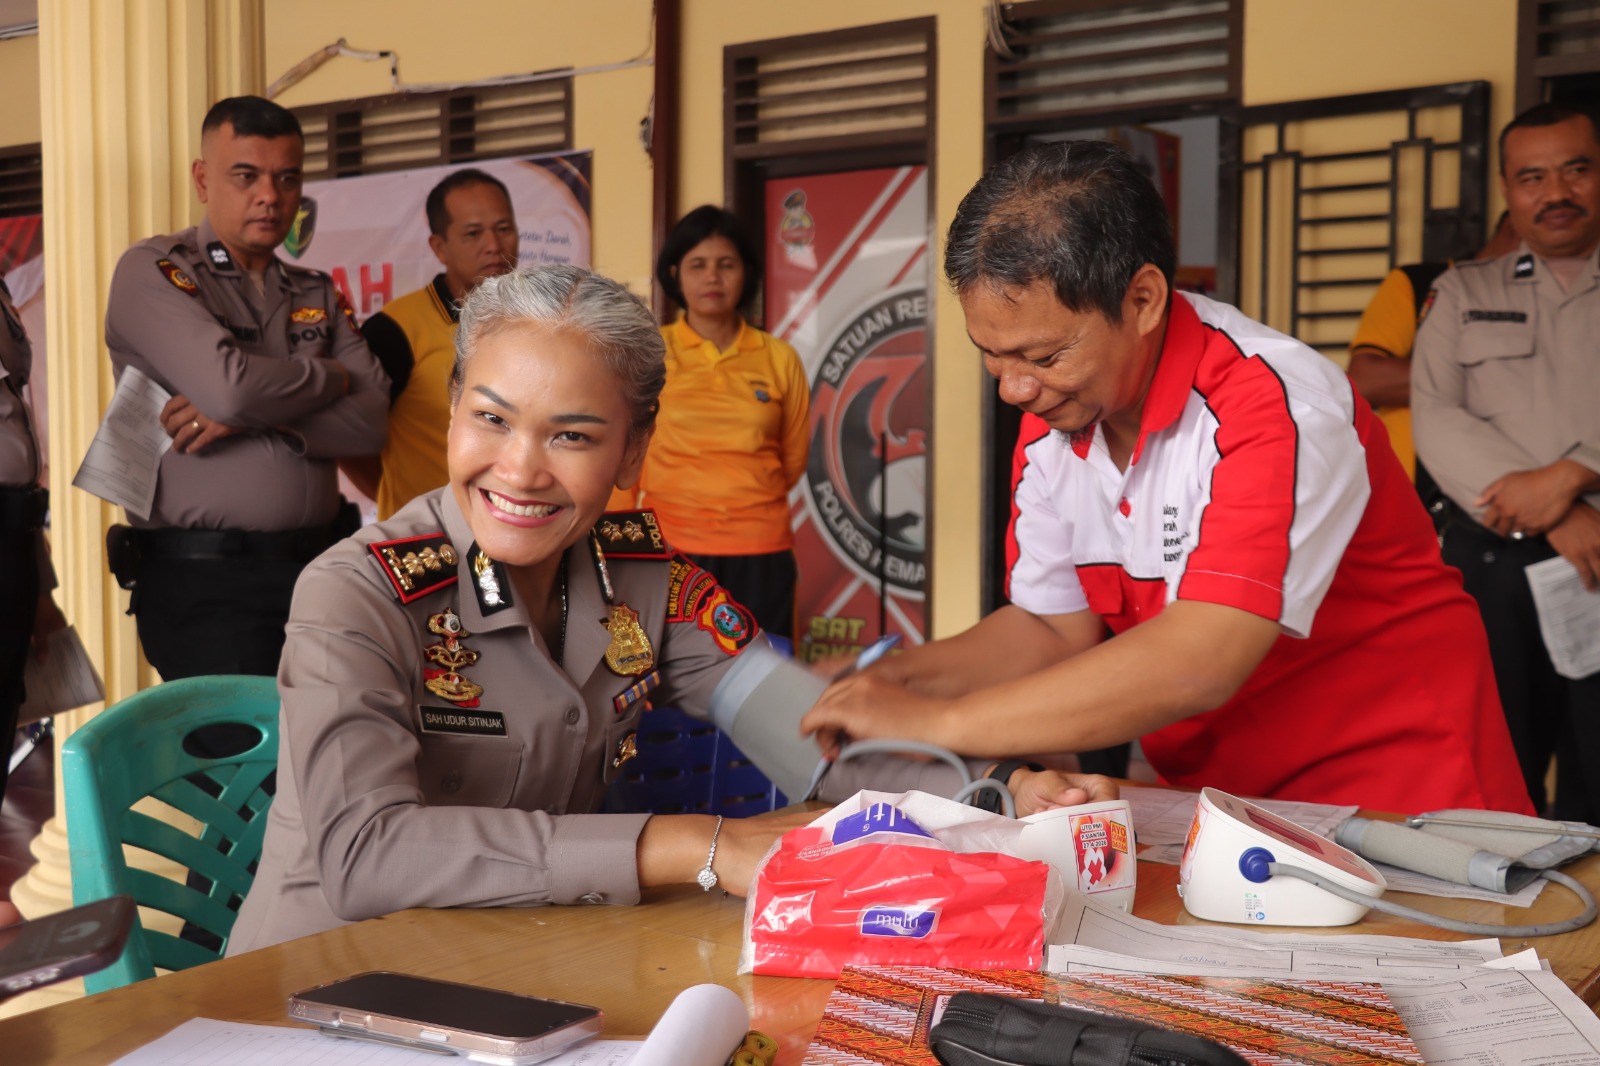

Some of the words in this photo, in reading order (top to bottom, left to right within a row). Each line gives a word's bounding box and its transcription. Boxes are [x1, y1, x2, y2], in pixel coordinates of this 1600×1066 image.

[822, 306, 893, 383] SATUAN
[644, 512, 664, 549] POLISI
[815, 481, 873, 561] POLRES
[811, 616, 866, 641] SAT
[425, 713, 443, 724] SAH
[443, 715, 468, 726] UDUR
[468, 716, 504, 728] SITINJAK
[1112, 824, 1126, 836] AYO
